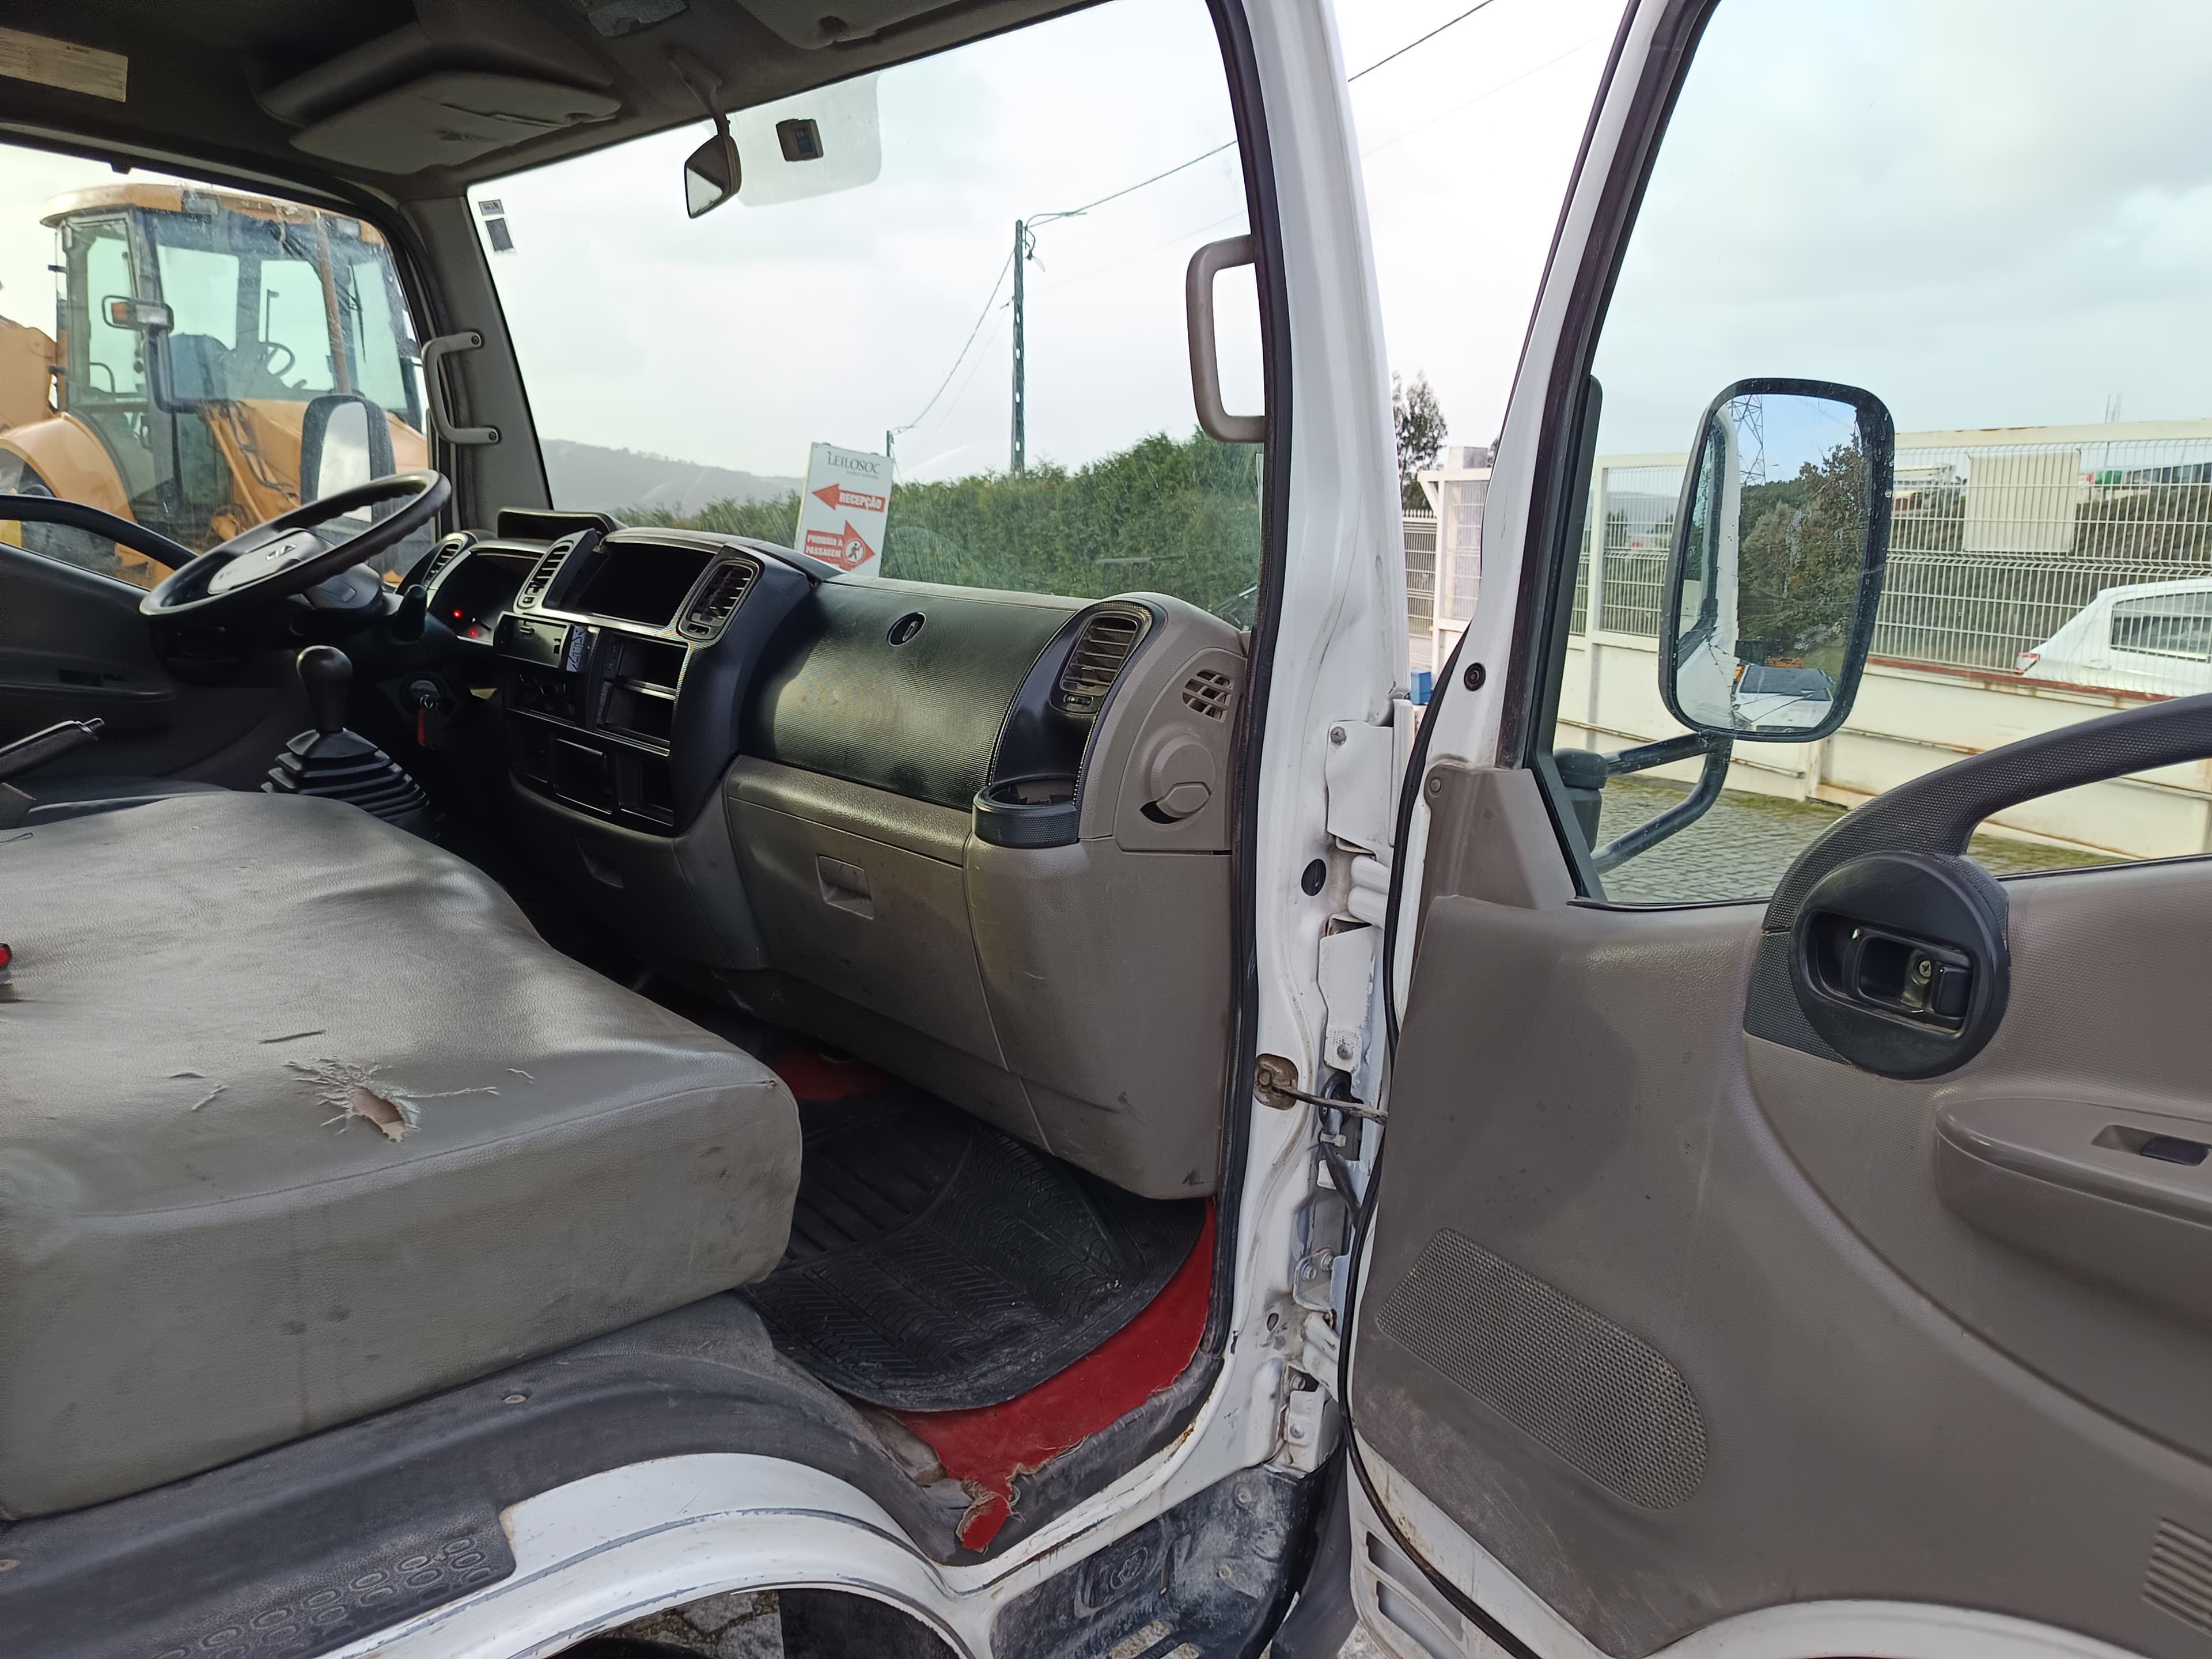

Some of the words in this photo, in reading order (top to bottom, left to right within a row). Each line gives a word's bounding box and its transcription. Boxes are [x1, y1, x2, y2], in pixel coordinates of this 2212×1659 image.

[828, 452, 880, 474] LEILOSOC
[839, 492, 882, 510] RECEPÇÃO
[805, 546, 841, 558] PASSAGEM
